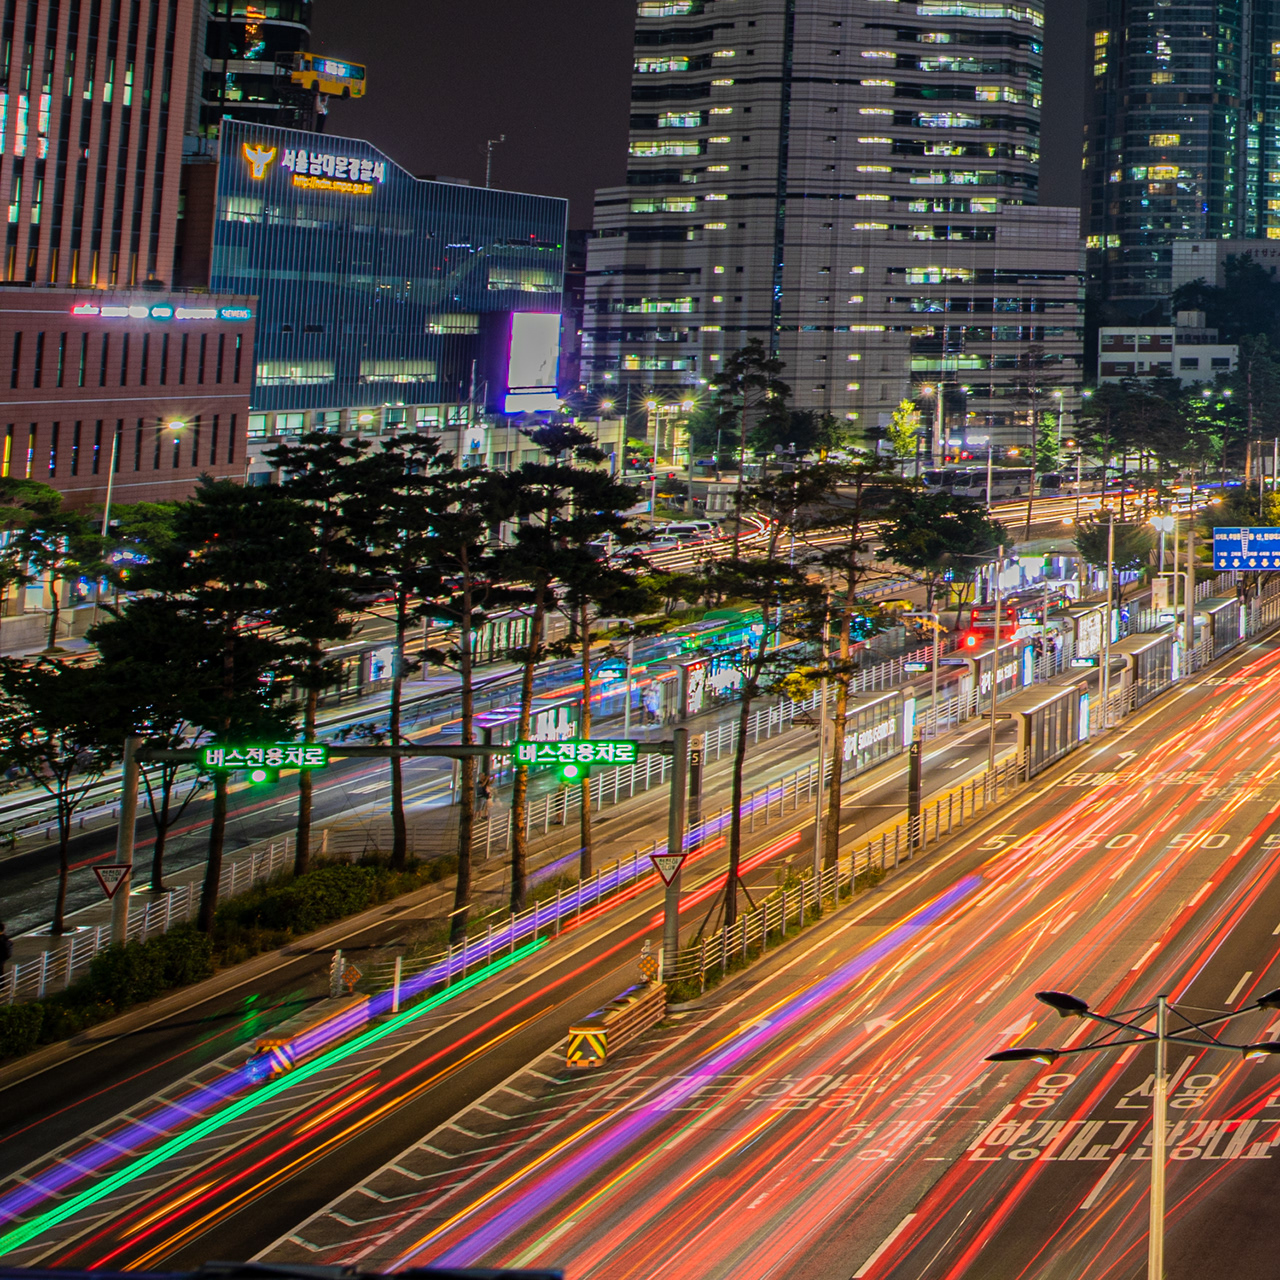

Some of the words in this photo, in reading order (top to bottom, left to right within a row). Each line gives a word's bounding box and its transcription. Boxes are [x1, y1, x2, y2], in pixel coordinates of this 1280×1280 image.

[281, 149, 386, 183] 서울남대문경찰서
[221, 309, 249, 319] SIEMENS
[205, 748, 324, 768] 버스전용차로
[519, 743, 635, 763] 버스전용차로
[911, 744, 918, 753] 4
[968, 1119, 1136, 1161] 한강대교
